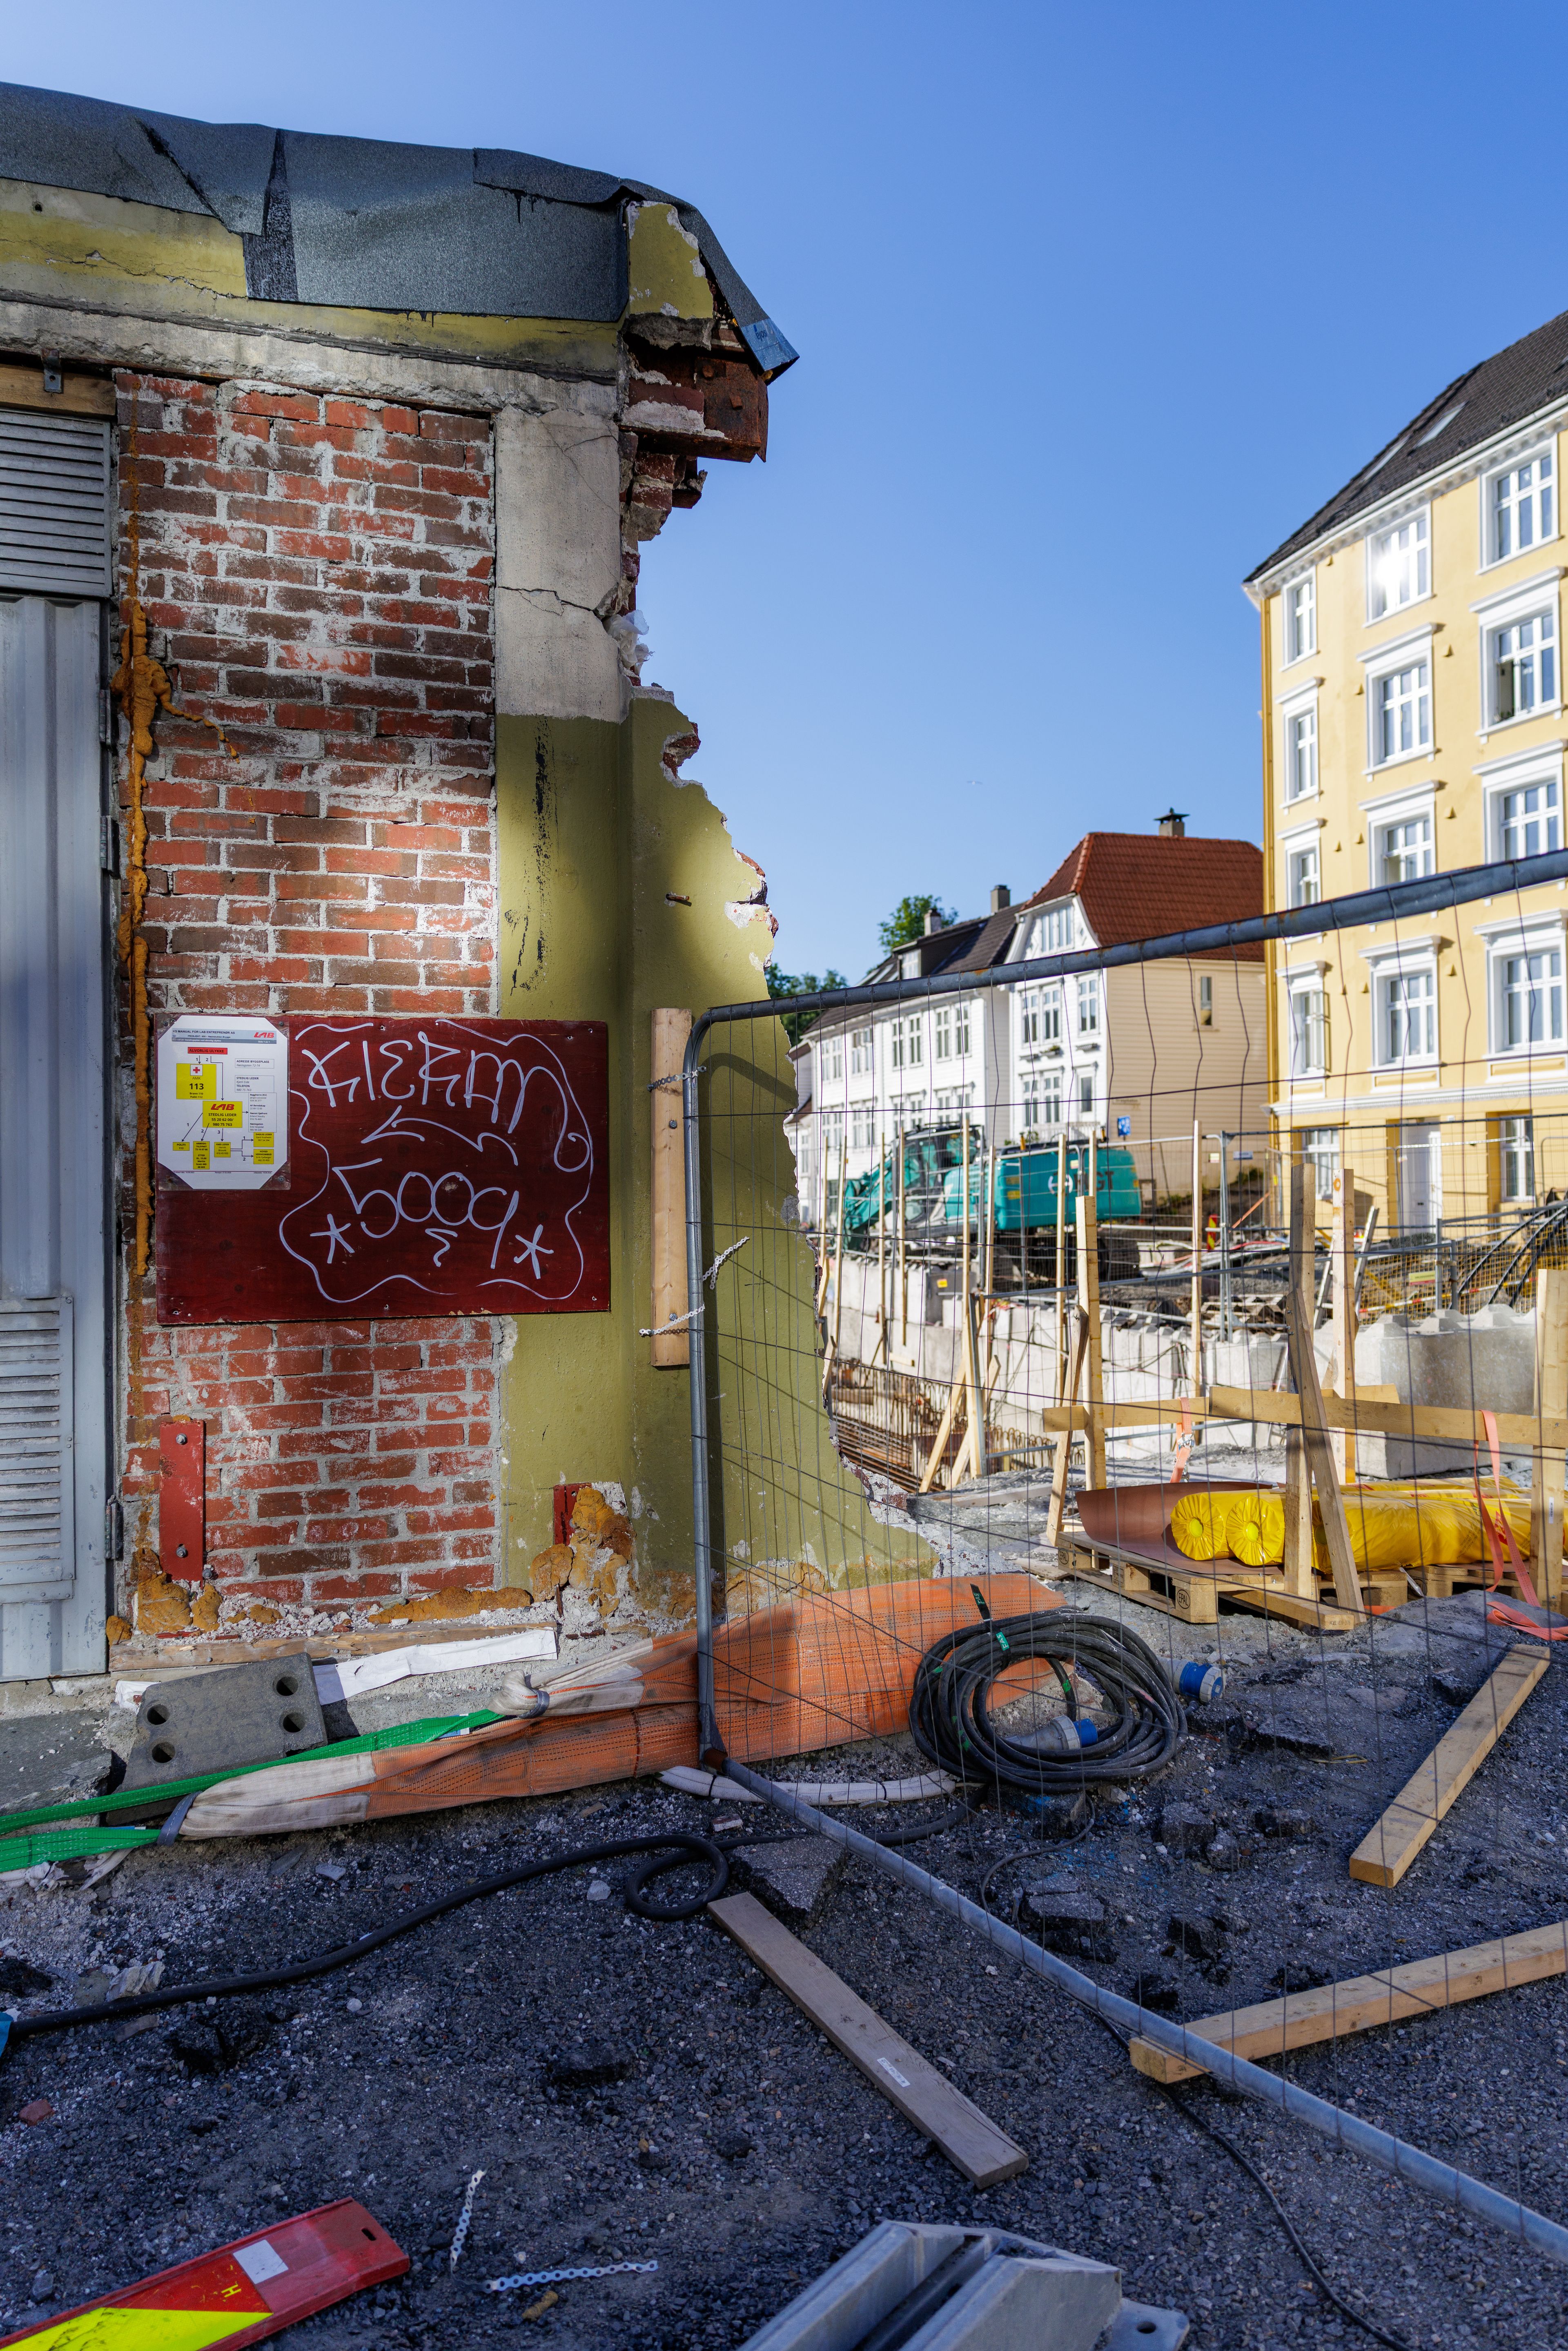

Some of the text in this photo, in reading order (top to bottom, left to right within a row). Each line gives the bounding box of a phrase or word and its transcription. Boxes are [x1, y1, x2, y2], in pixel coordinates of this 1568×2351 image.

[1178, 1593, 1189, 1607] EPAL
[997, 1634, 1009, 1649] FAS
[221, 2284, 242, 2298] H
